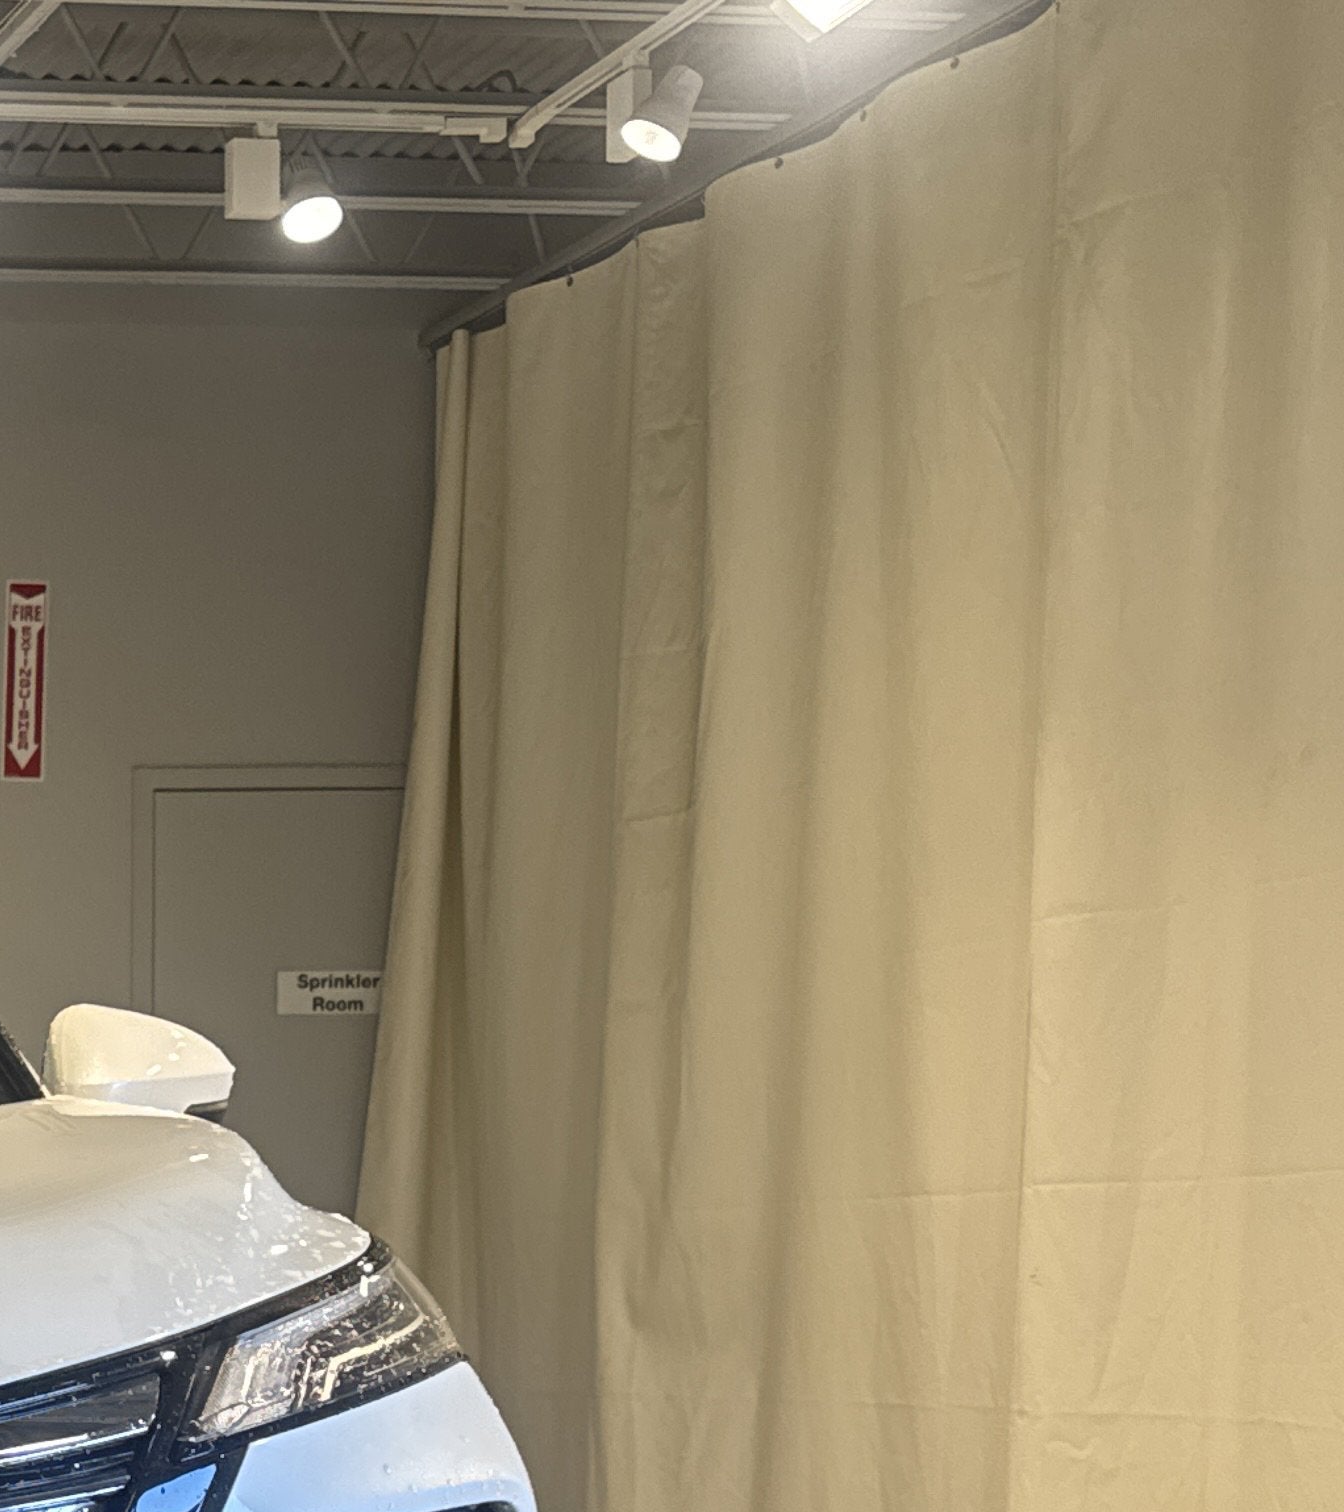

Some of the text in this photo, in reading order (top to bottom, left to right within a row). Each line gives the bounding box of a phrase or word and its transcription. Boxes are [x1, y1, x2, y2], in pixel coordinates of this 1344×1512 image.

[12, 604, 42, 622] FIRE
[17, 626, 32, 750] EXTINGUISHER
[297, 974, 380, 992] Sprinkler
[312, 996, 364, 1011] Room
